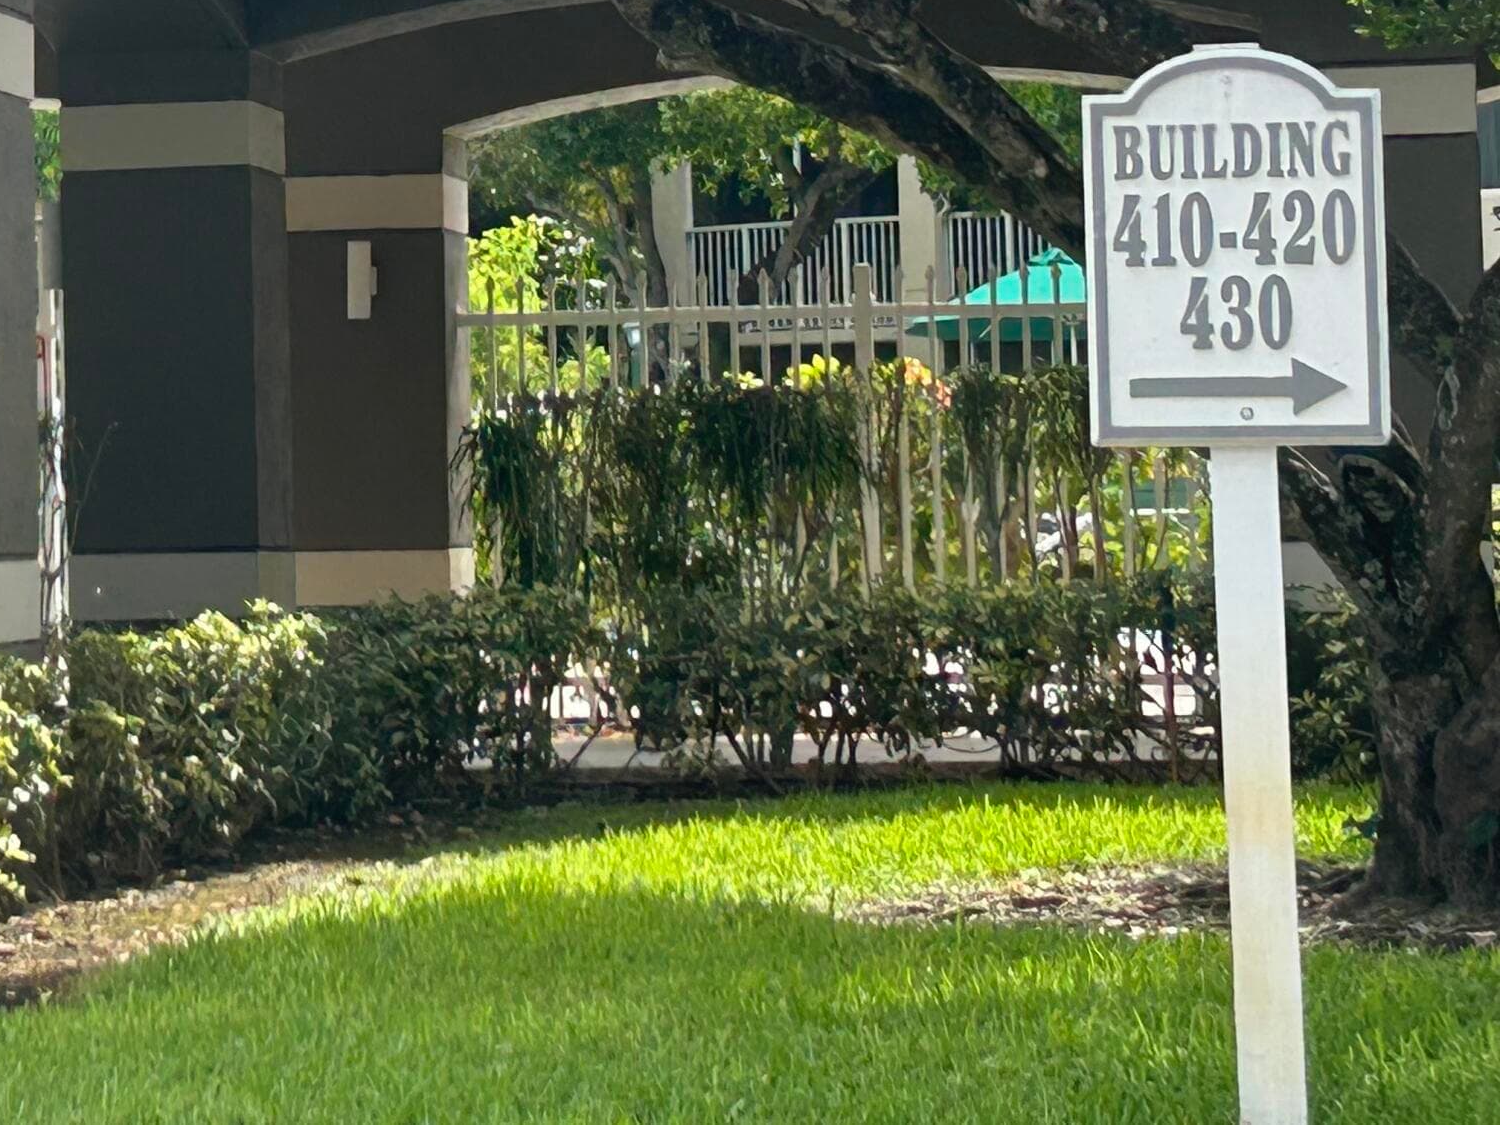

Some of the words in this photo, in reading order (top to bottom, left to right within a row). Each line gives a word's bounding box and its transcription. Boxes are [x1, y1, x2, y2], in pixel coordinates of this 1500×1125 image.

[1113, 120, 1352, 181] BUILDING
[1112, 188, 1357, 268] 410-420
[1180, 273, 1293, 351] 430
